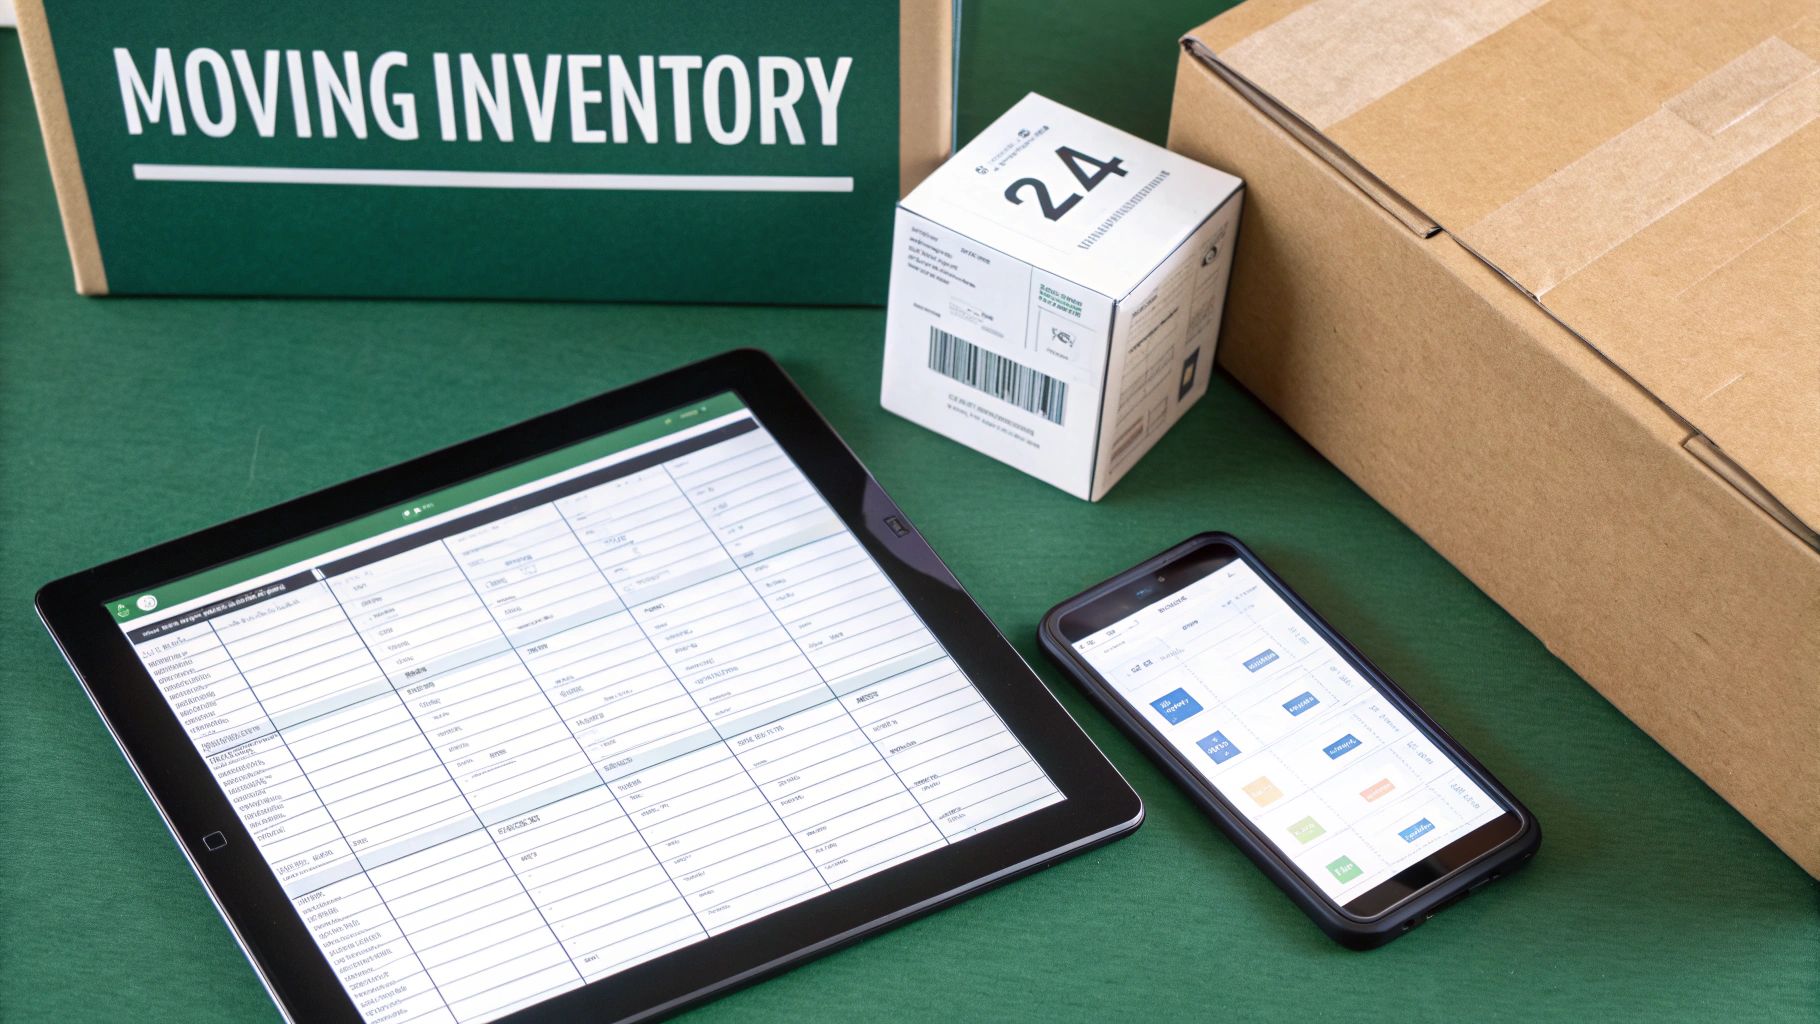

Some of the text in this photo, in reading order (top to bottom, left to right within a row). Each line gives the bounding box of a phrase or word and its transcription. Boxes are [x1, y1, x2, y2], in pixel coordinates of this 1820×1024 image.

[114, 48, 853, 145] MOVING INVENTORY
[1004, 146, 1128, 222] 24
